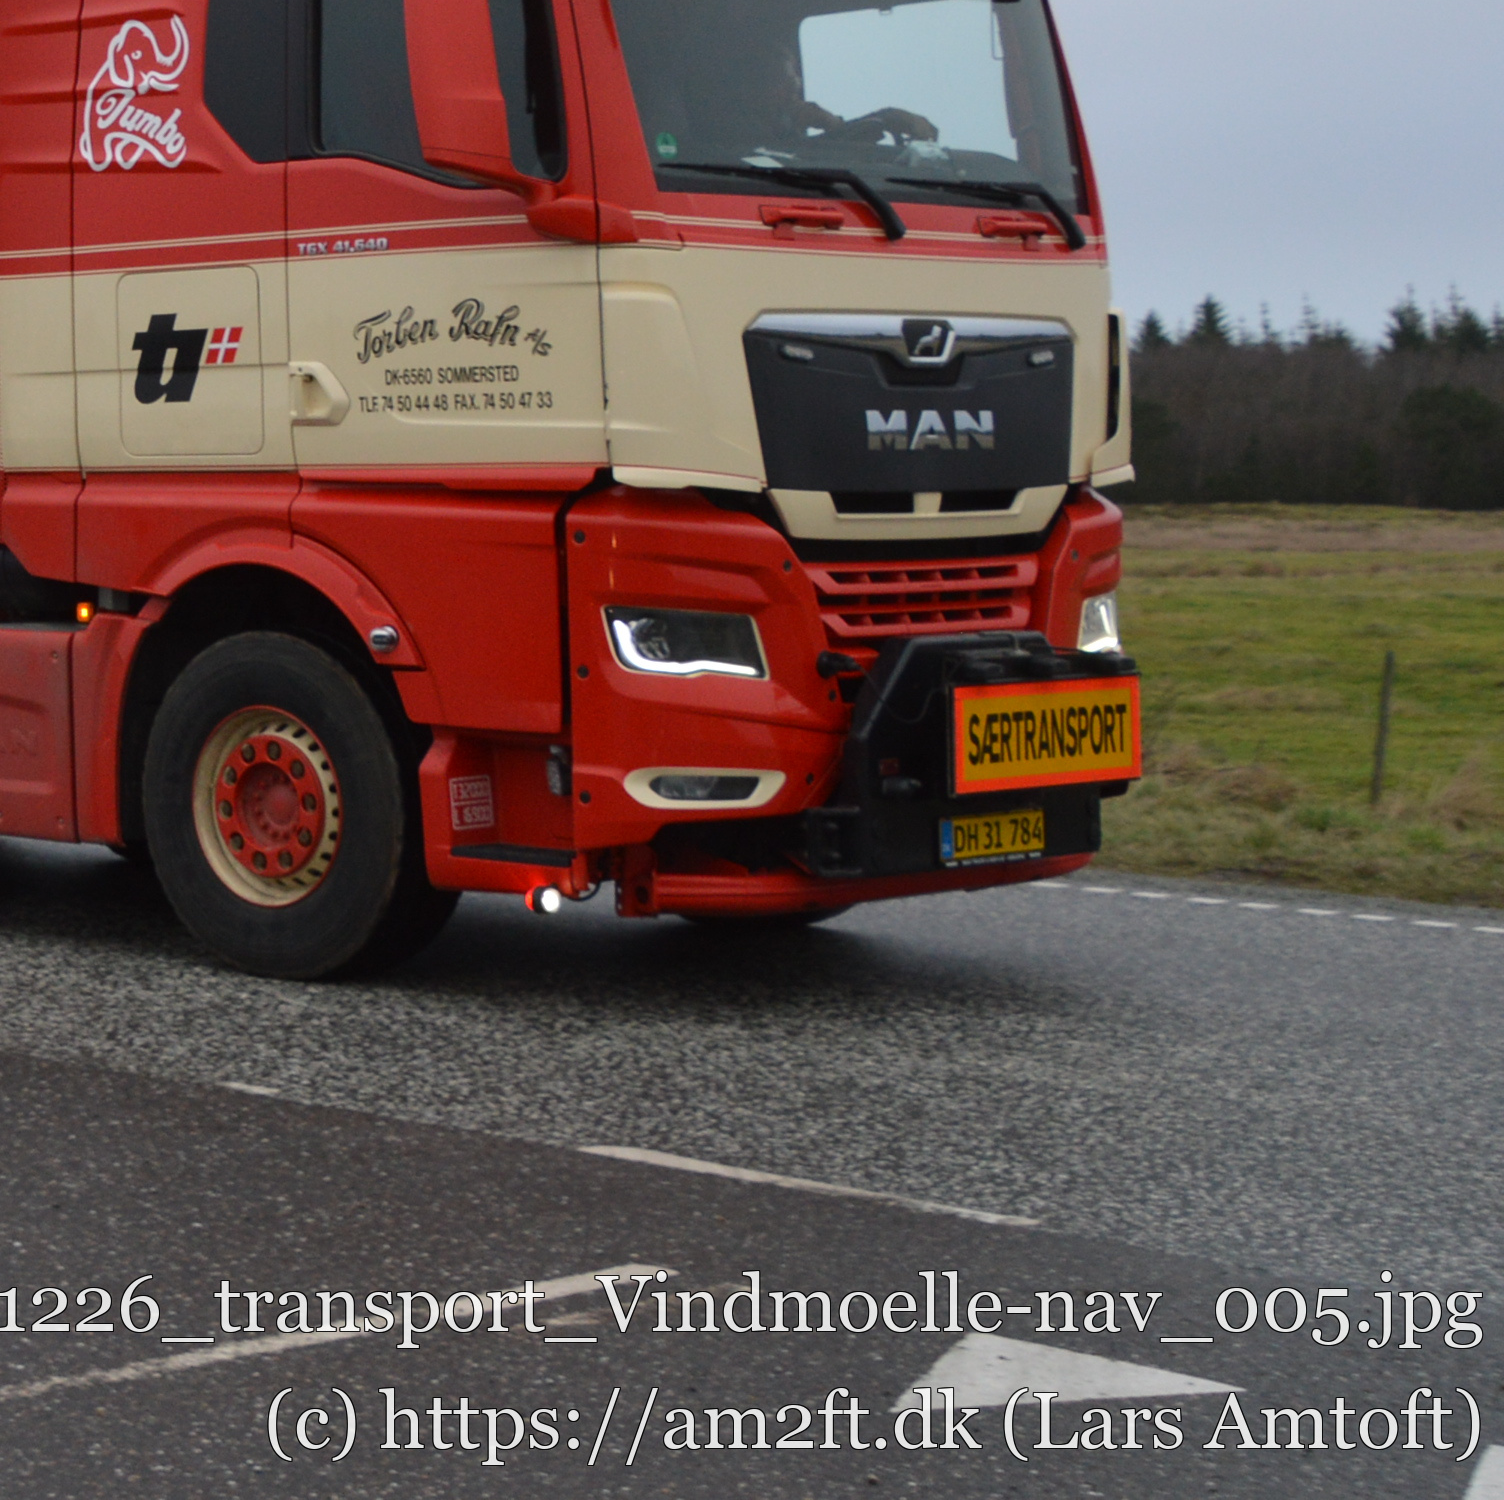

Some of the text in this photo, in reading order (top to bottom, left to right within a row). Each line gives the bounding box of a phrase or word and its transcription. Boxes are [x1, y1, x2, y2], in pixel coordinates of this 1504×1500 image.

[96, 88, 187, 155] Jumbo
[354, 306, 440, 364] Torben
[449, 298, 521, 347] Rafn
[384, 365, 520, 386] DK-6560 SOMMERSTED
[397, 394, 413, 412] 50
[414, 394, 430, 411] 44
[432, 393, 449, 411] 48
[454, 393, 480, 411] FAX.
[482, 392, 496, 410] 74
[499, 392, 515, 410] 50
[518, 391, 533, 409] 47
[536, 391, 553, 409] 33
[864, 409, 995, 451] MAN
[968, 703, 1127, 765] SÆRTRANSPORT
[955, 816, 1042, 852] DH 31 784
